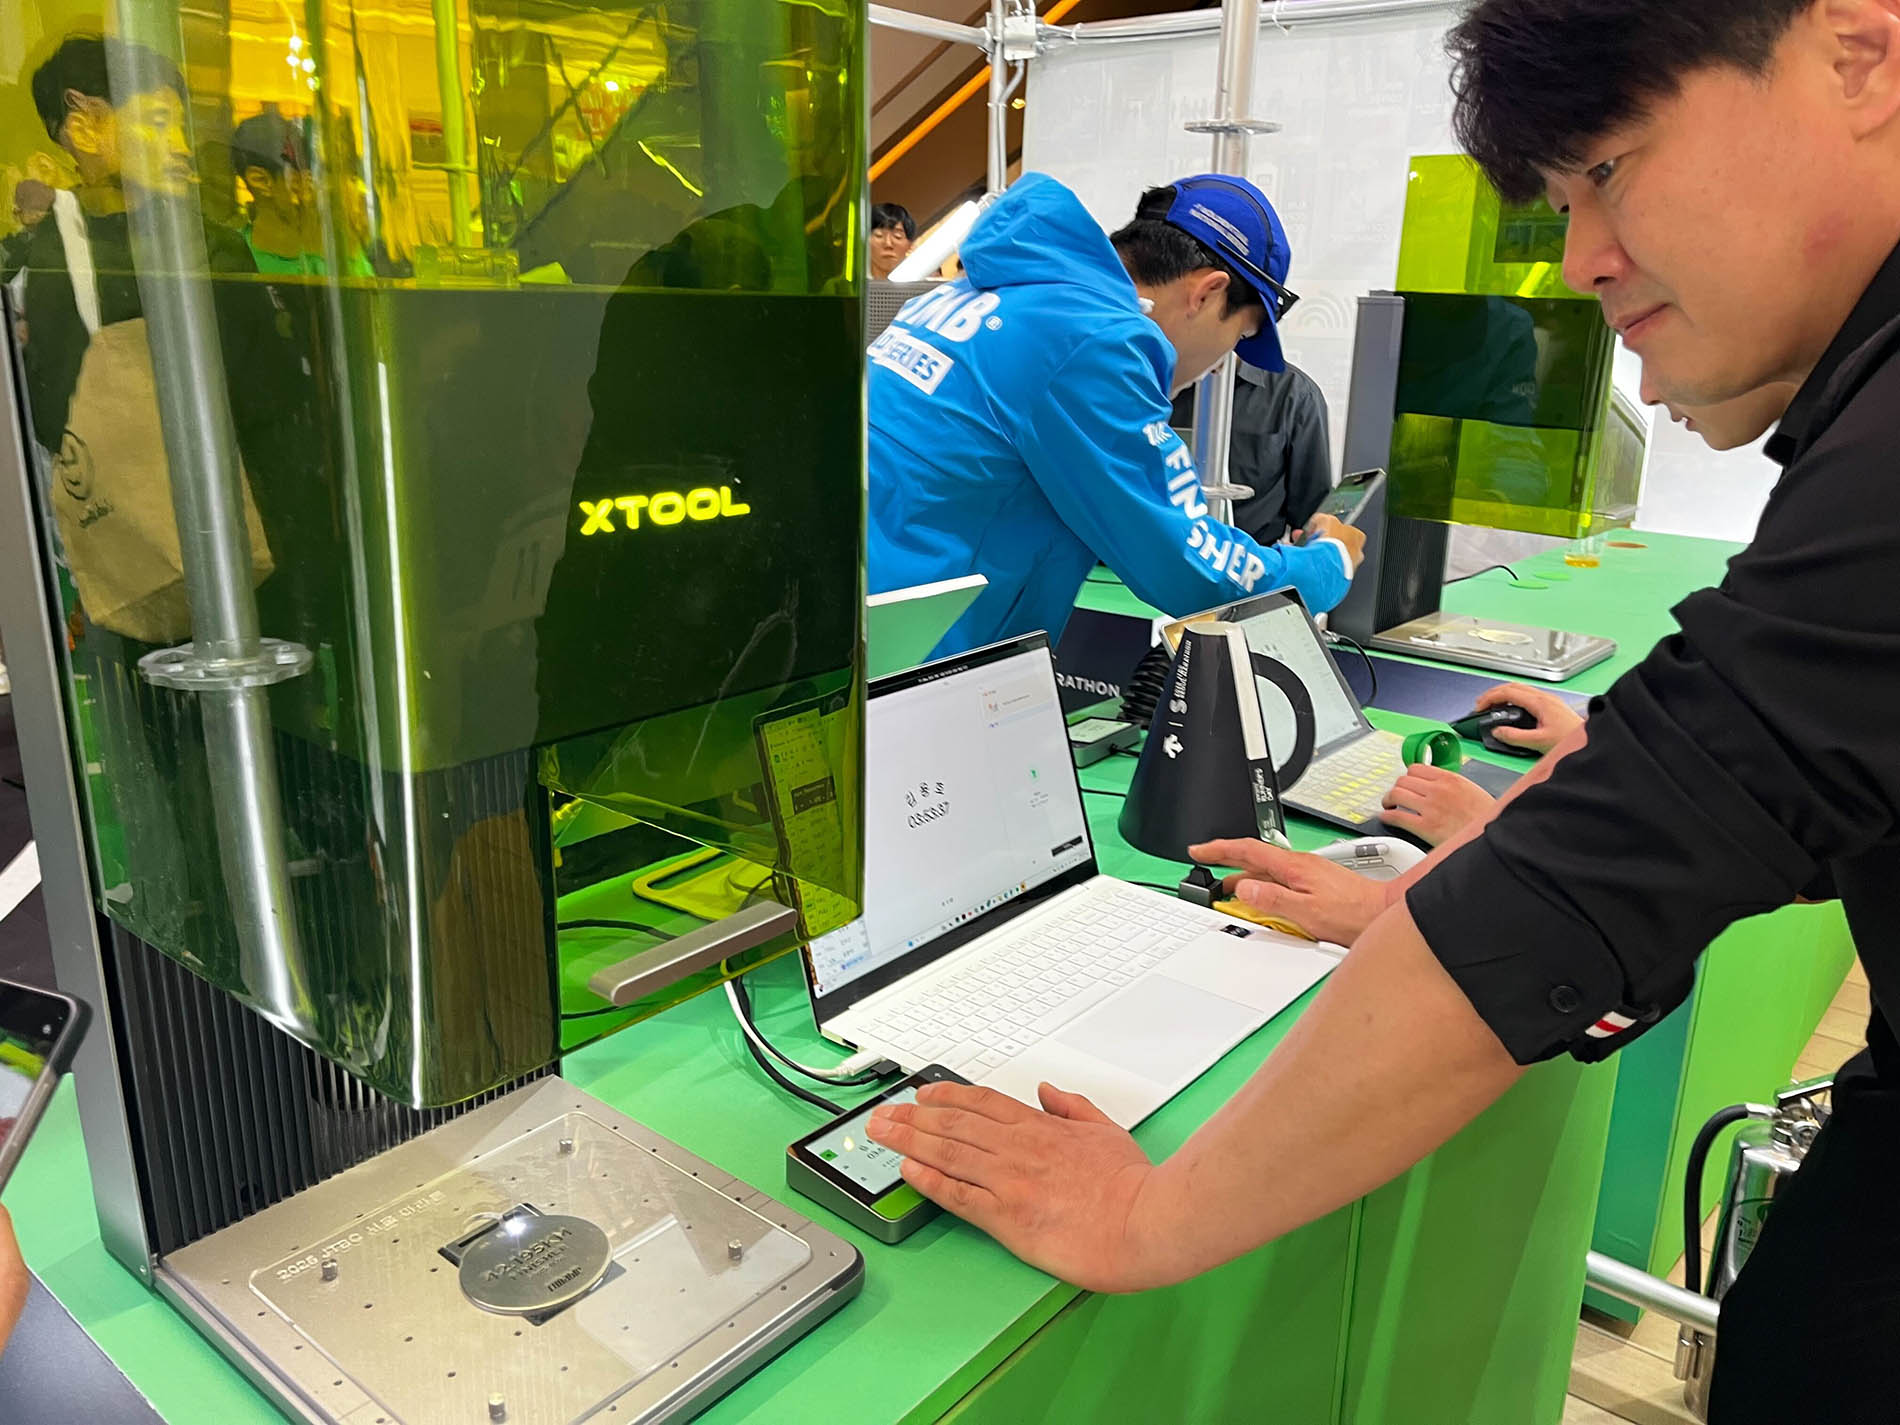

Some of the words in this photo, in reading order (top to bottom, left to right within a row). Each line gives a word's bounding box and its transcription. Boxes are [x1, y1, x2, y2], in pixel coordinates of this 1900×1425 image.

[579, 486, 751, 536] XTOOL
[1165, 444, 1266, 594] FINSHER
[1055, 672, 1121, 698] RATHON
